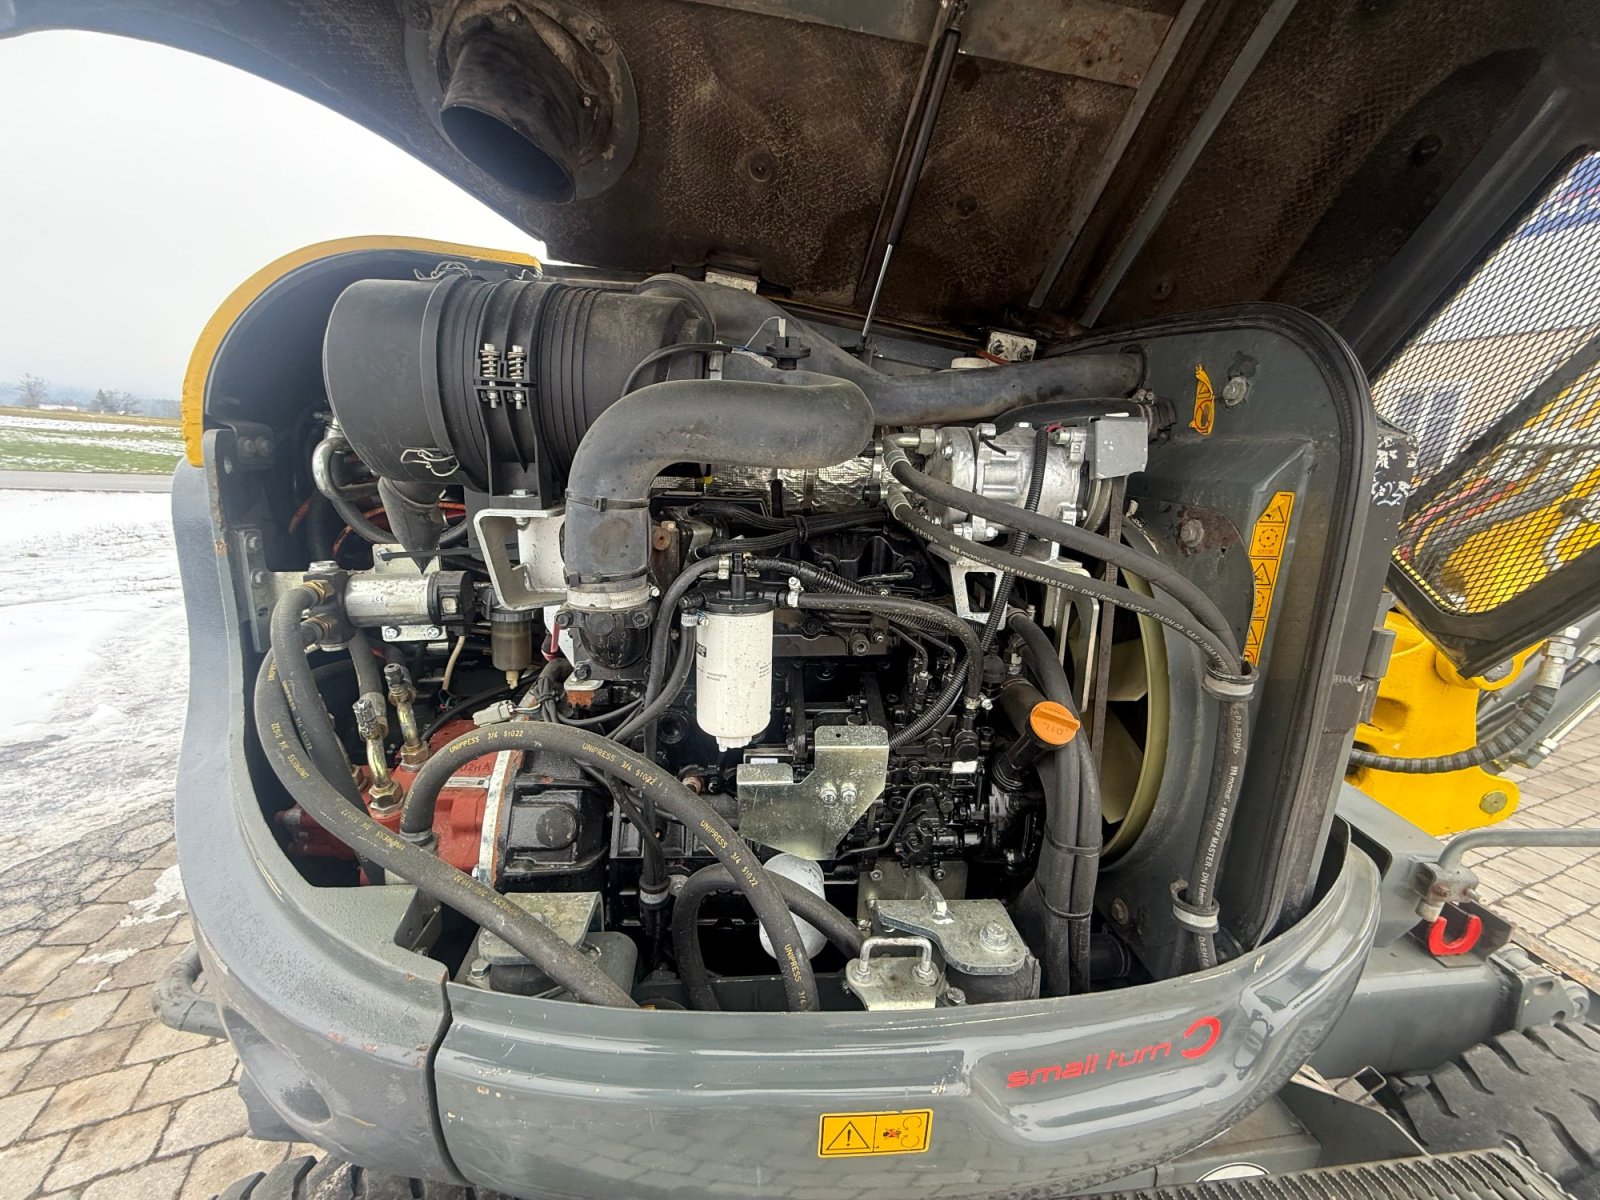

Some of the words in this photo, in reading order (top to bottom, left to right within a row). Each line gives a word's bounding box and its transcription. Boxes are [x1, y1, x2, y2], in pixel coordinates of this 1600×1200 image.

[1036, 575, 1074, 590] MASTER
[448, 735, 481, 754] UNIPRESS
[487, 731, 498, 740] 3/4
[582, 742, 616, 762] UNIPRESS
[620, 761, 632, 772] 3/4
[700, 819, 728, 850] UNIPRESS
[730, 851, 741, 865] 3/4
[1203, 835, 1220, 868] MASTER
[1200, 871, 1210, 884] DN
[1197, 935, 1209, 958] DASH
[783, 943, 802, 983] UNIPRESS
[1007, 1053, 1099, 1089] small
[1106, 1042, 1172, 1070] turn
